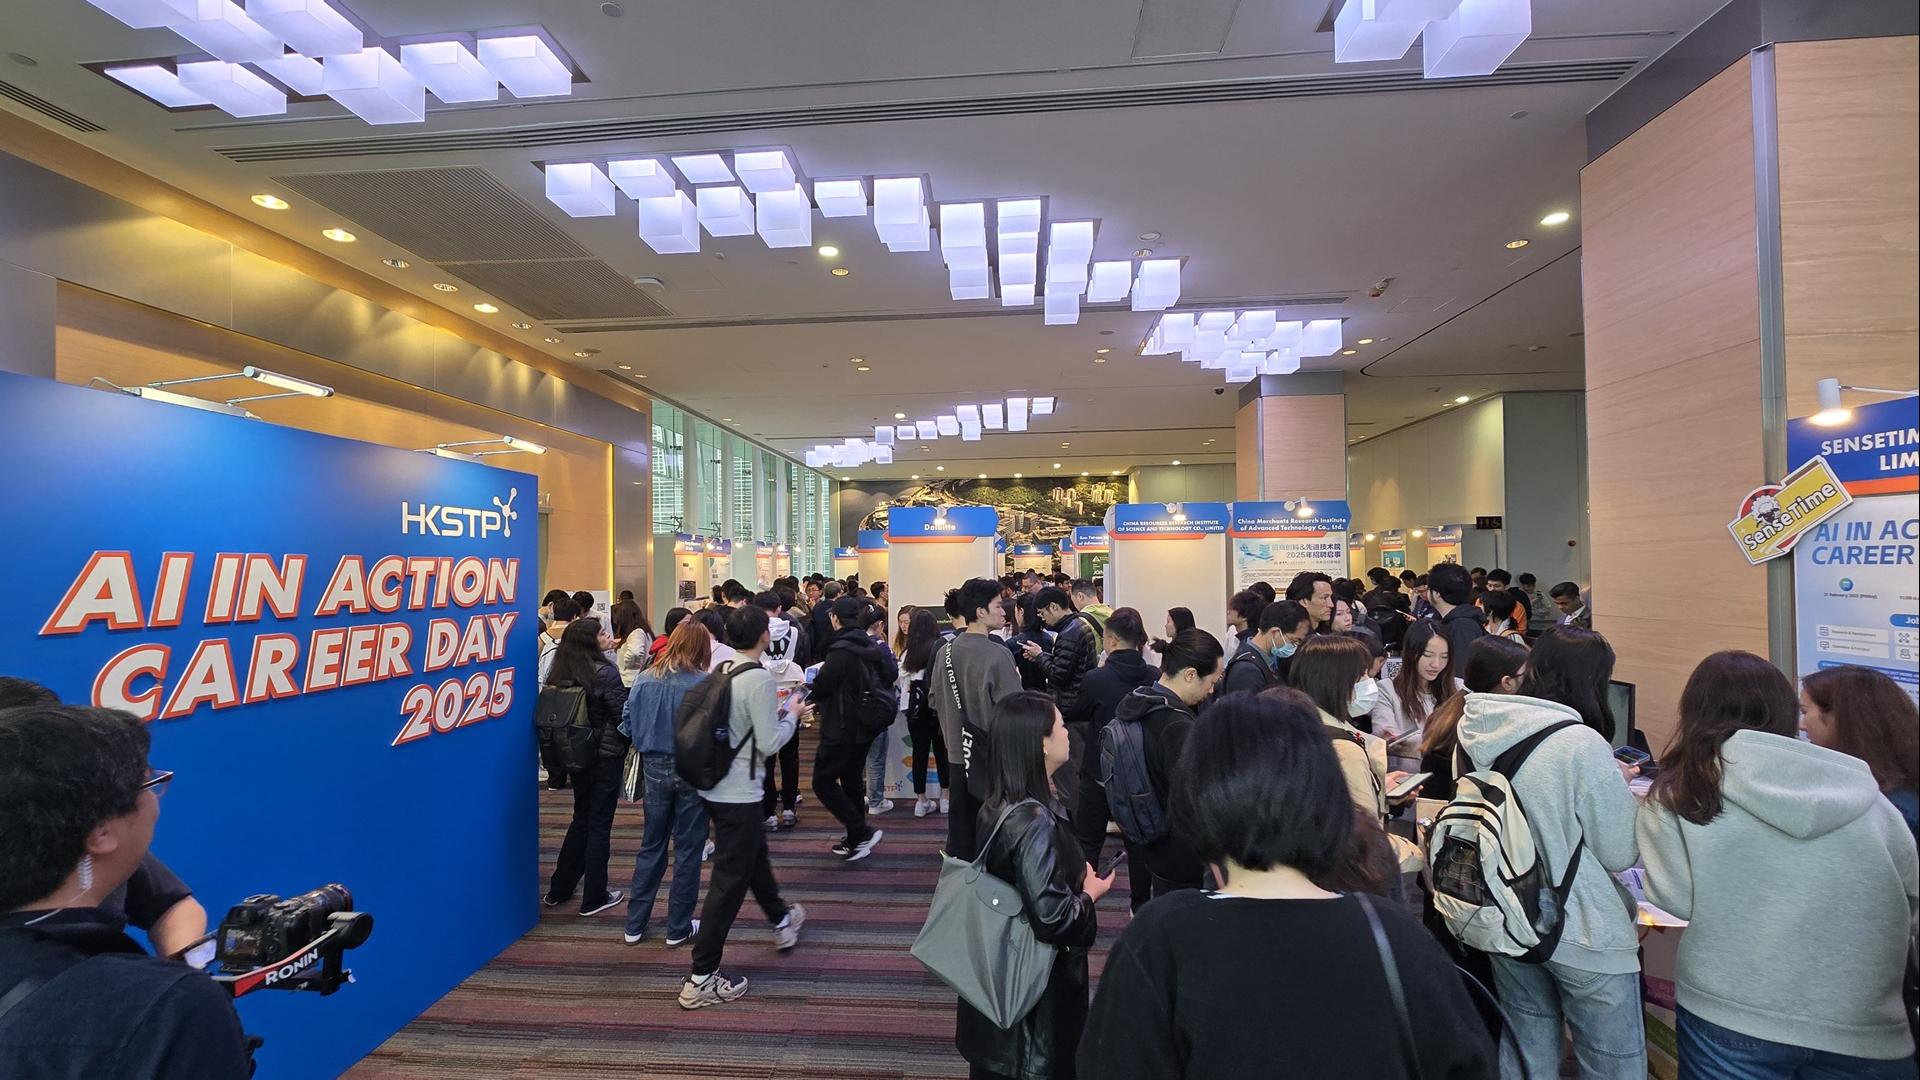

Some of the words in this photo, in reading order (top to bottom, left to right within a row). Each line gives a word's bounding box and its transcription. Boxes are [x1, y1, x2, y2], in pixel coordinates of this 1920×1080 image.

[402, 501, 500, 538] HKSTP
[1743, 483, 1838, 551] SenseTime
[1814, 523, 1839, 542] AI
[1846, 521, 1872, 541] IN
[1811, 544, 1915, 565] CAREER
[37, 550, 195, 635] AI
[203, 552, 309, 624] IN
[314, 554, 520, 616] ACTION
[90, 621, 415, 724] CAREER
[423, 611, 520, 673] DAY
[390, 667, 516, 747] 2025
[265, 948, 318, 985] RONIN
